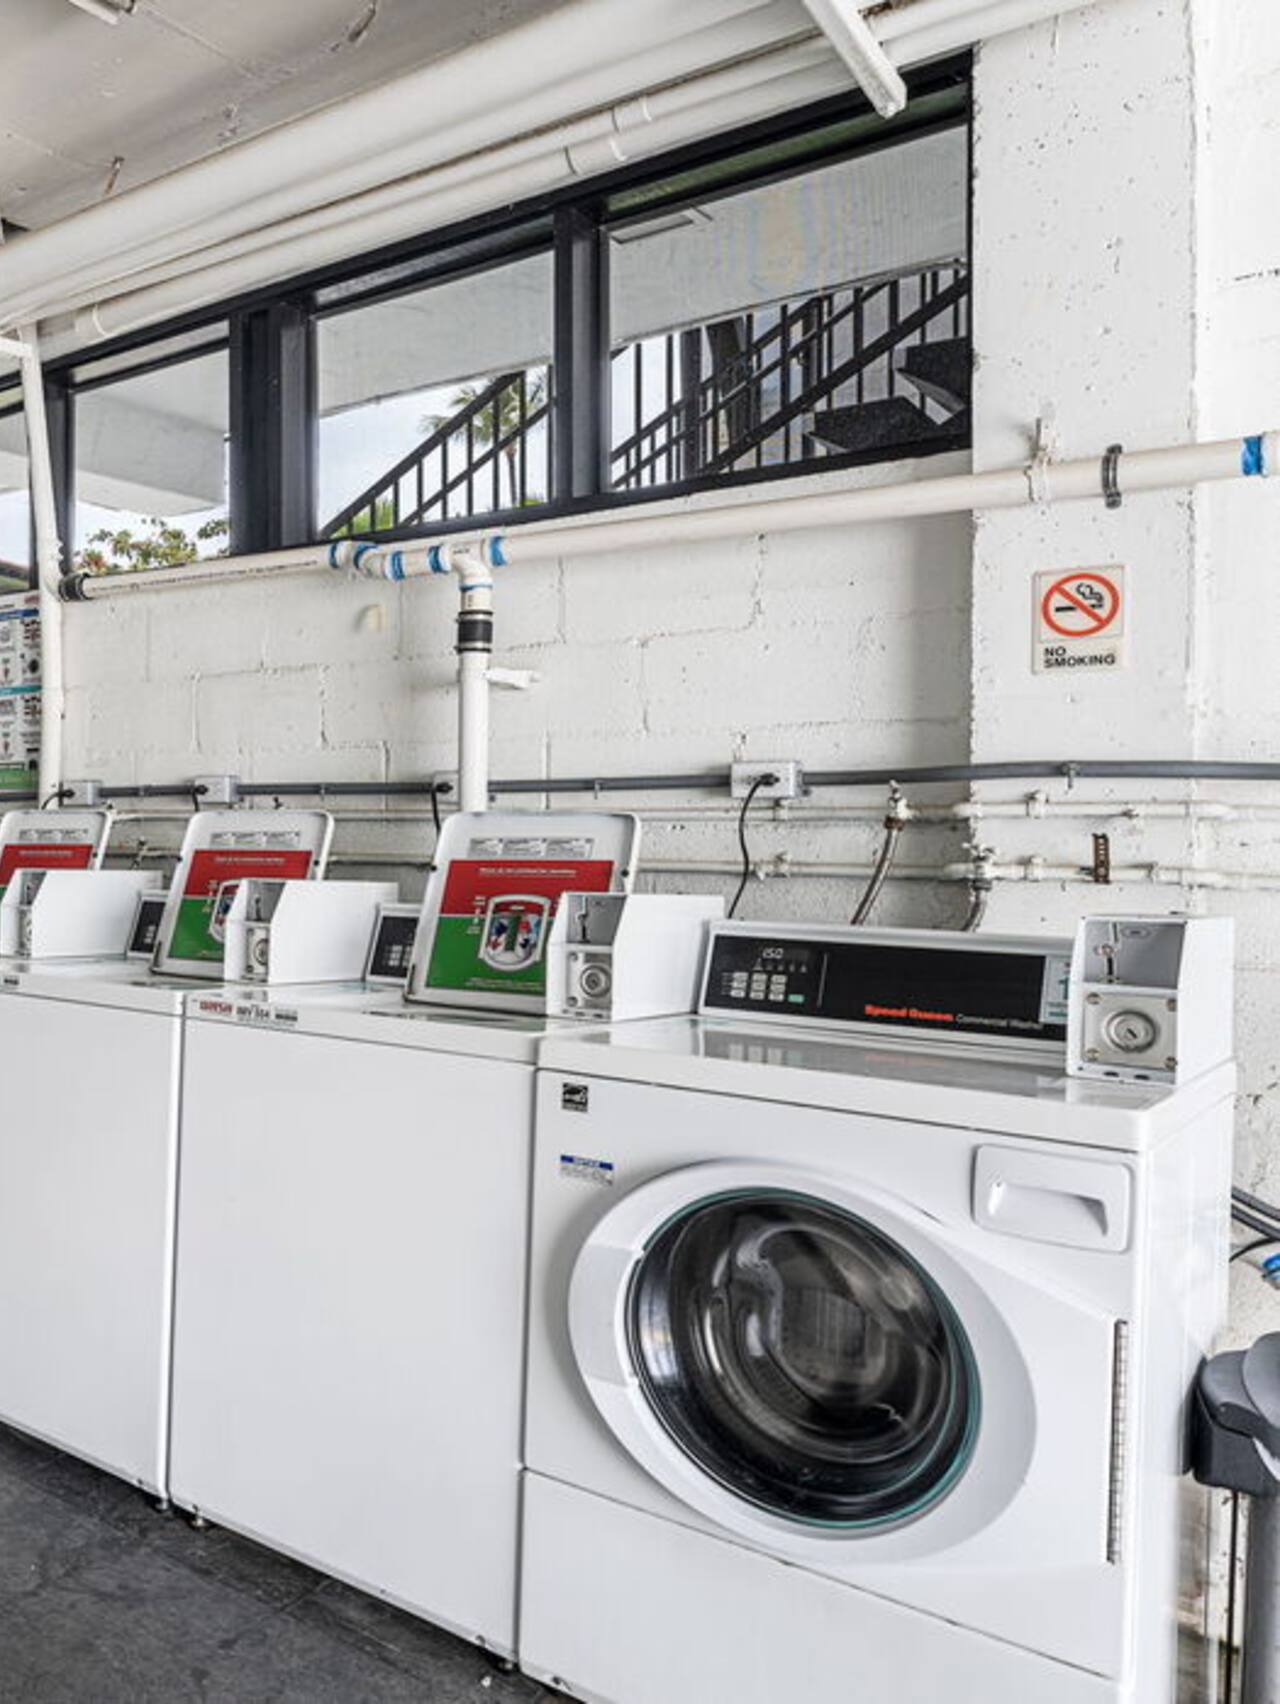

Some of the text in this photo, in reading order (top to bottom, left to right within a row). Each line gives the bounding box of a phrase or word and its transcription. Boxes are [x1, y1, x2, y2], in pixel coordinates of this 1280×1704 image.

[1044, 646, 1066, 657] NO
[1044, 653, 1116, 668] SMOKING
[865, 1004, 908, 1017] Speed
[909, 1007, 954, 1021] Queen
